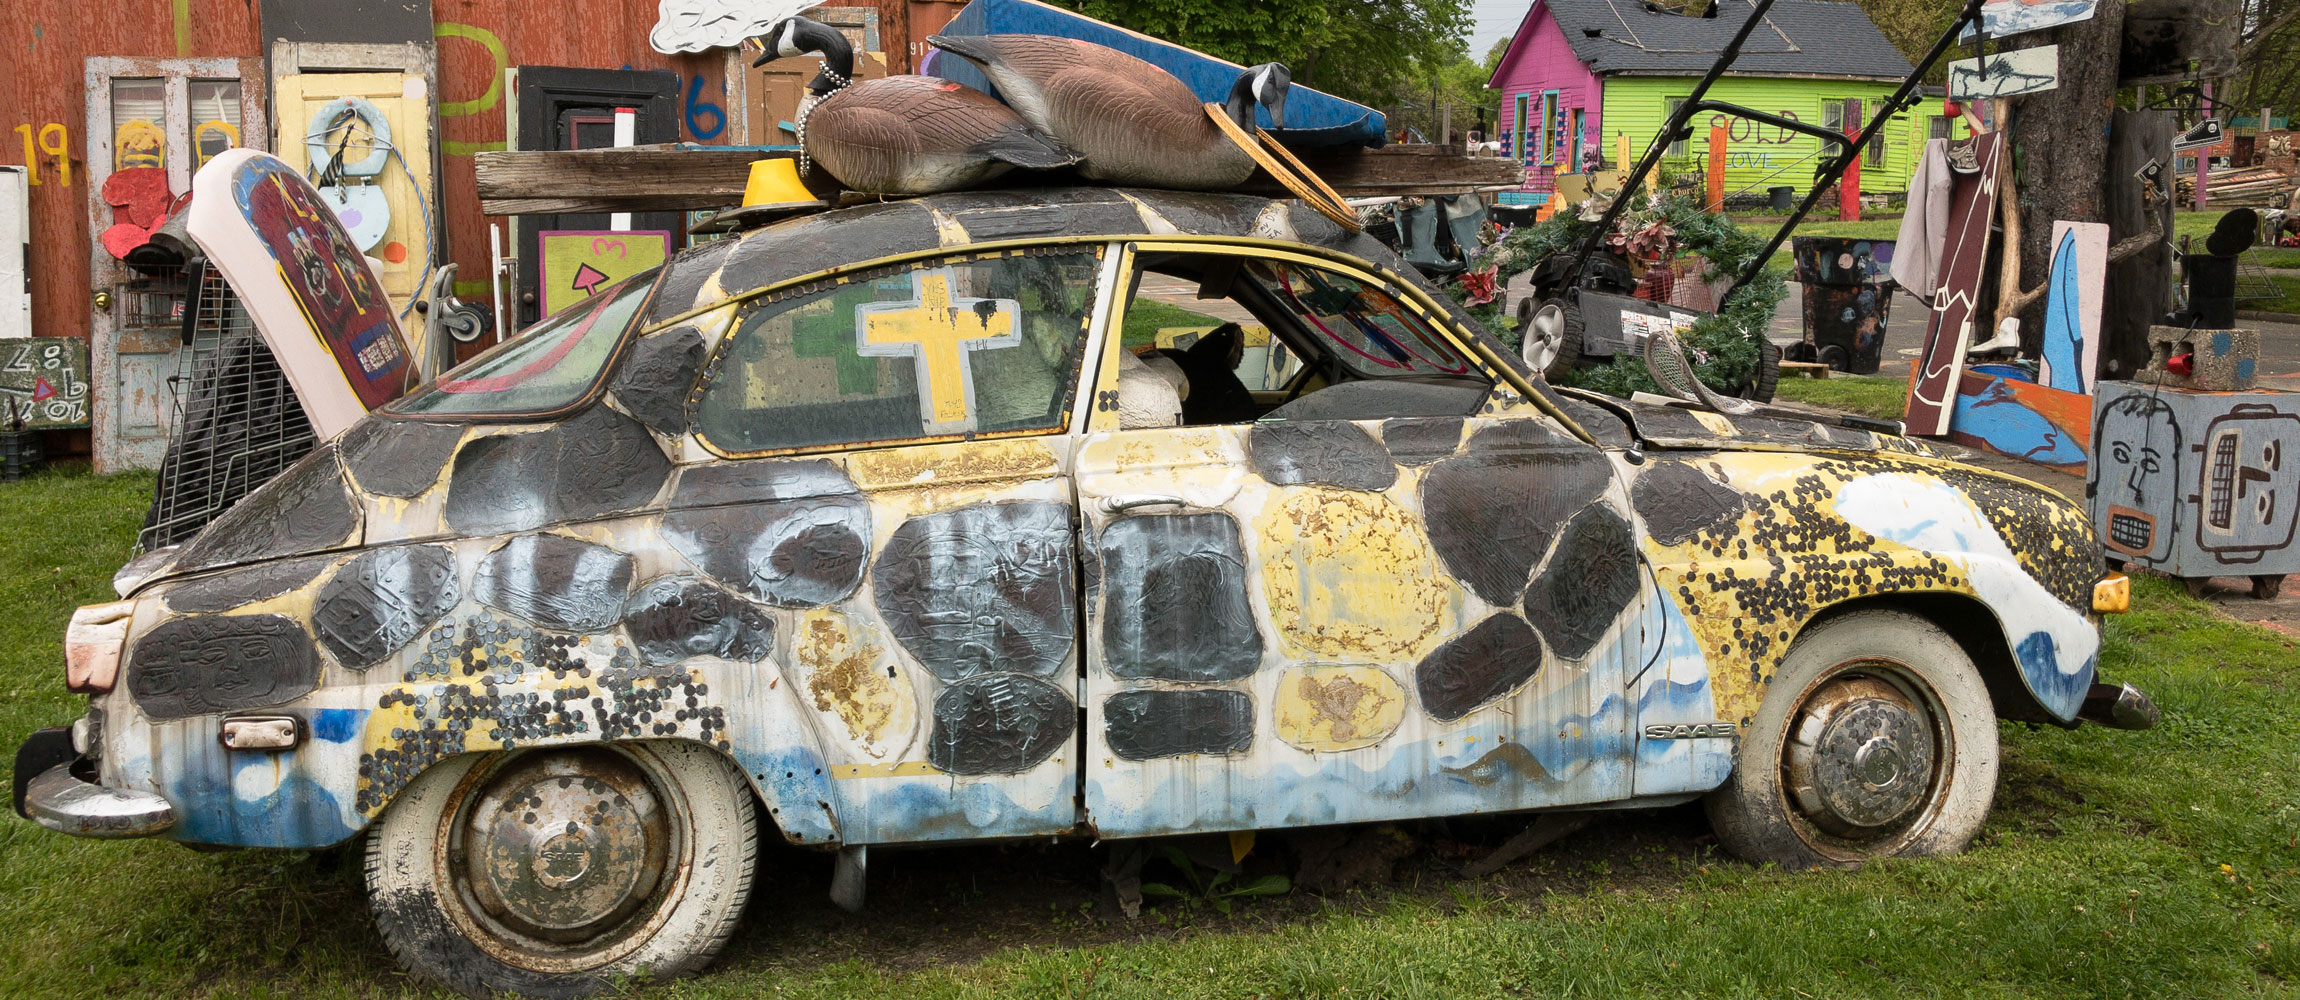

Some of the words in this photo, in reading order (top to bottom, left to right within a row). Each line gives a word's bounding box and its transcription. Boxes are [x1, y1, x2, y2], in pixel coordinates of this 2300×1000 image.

[684, 75, 726, 140] 6
[14, 122, 71, 187] 19
[1645, 723, 1737, 739] SAAB
